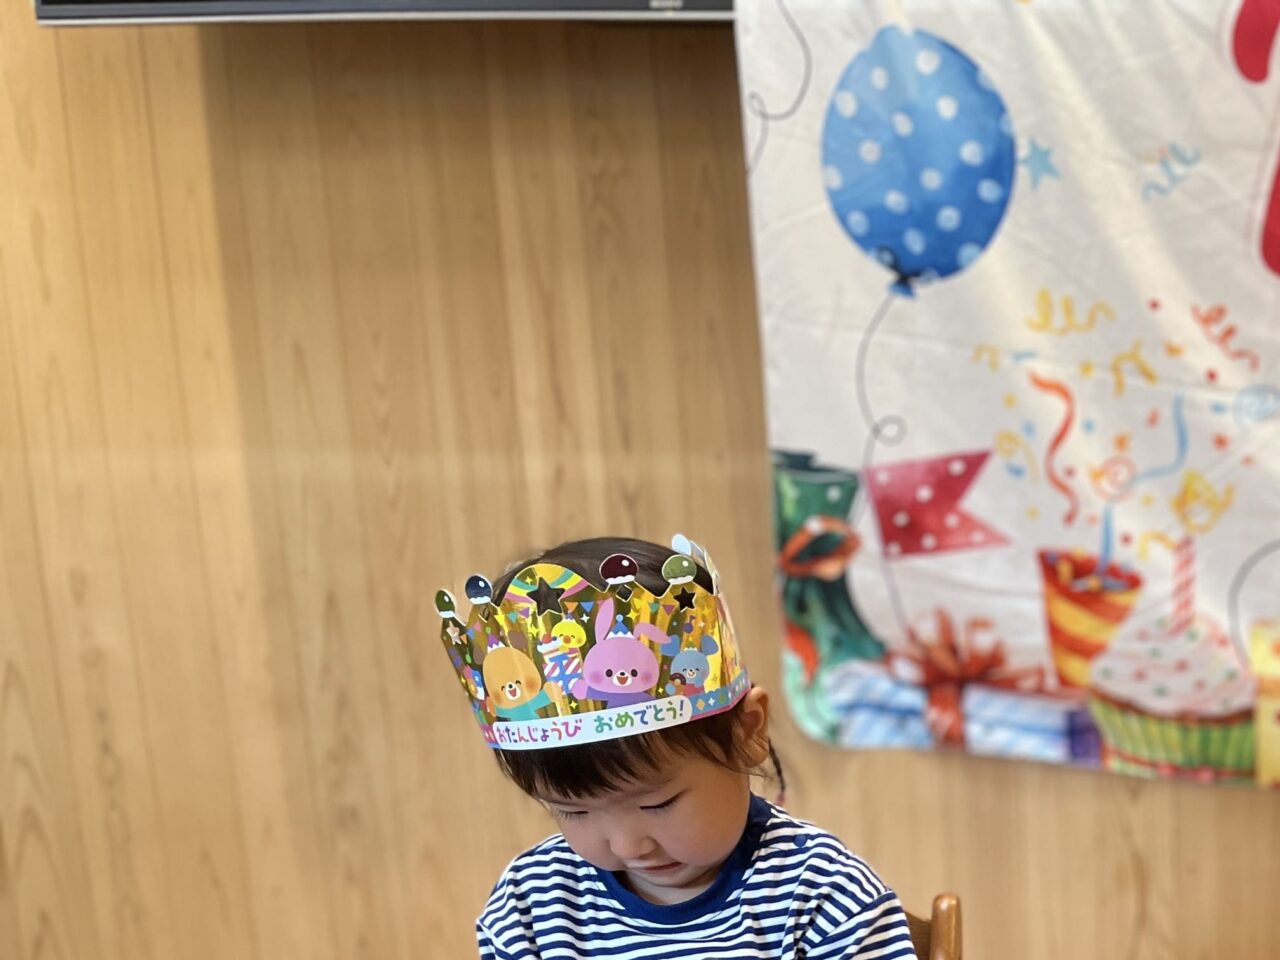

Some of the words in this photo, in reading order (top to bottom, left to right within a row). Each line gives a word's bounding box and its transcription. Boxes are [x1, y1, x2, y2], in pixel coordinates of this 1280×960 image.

[499, 718, 583, 744] おたんじょうび
